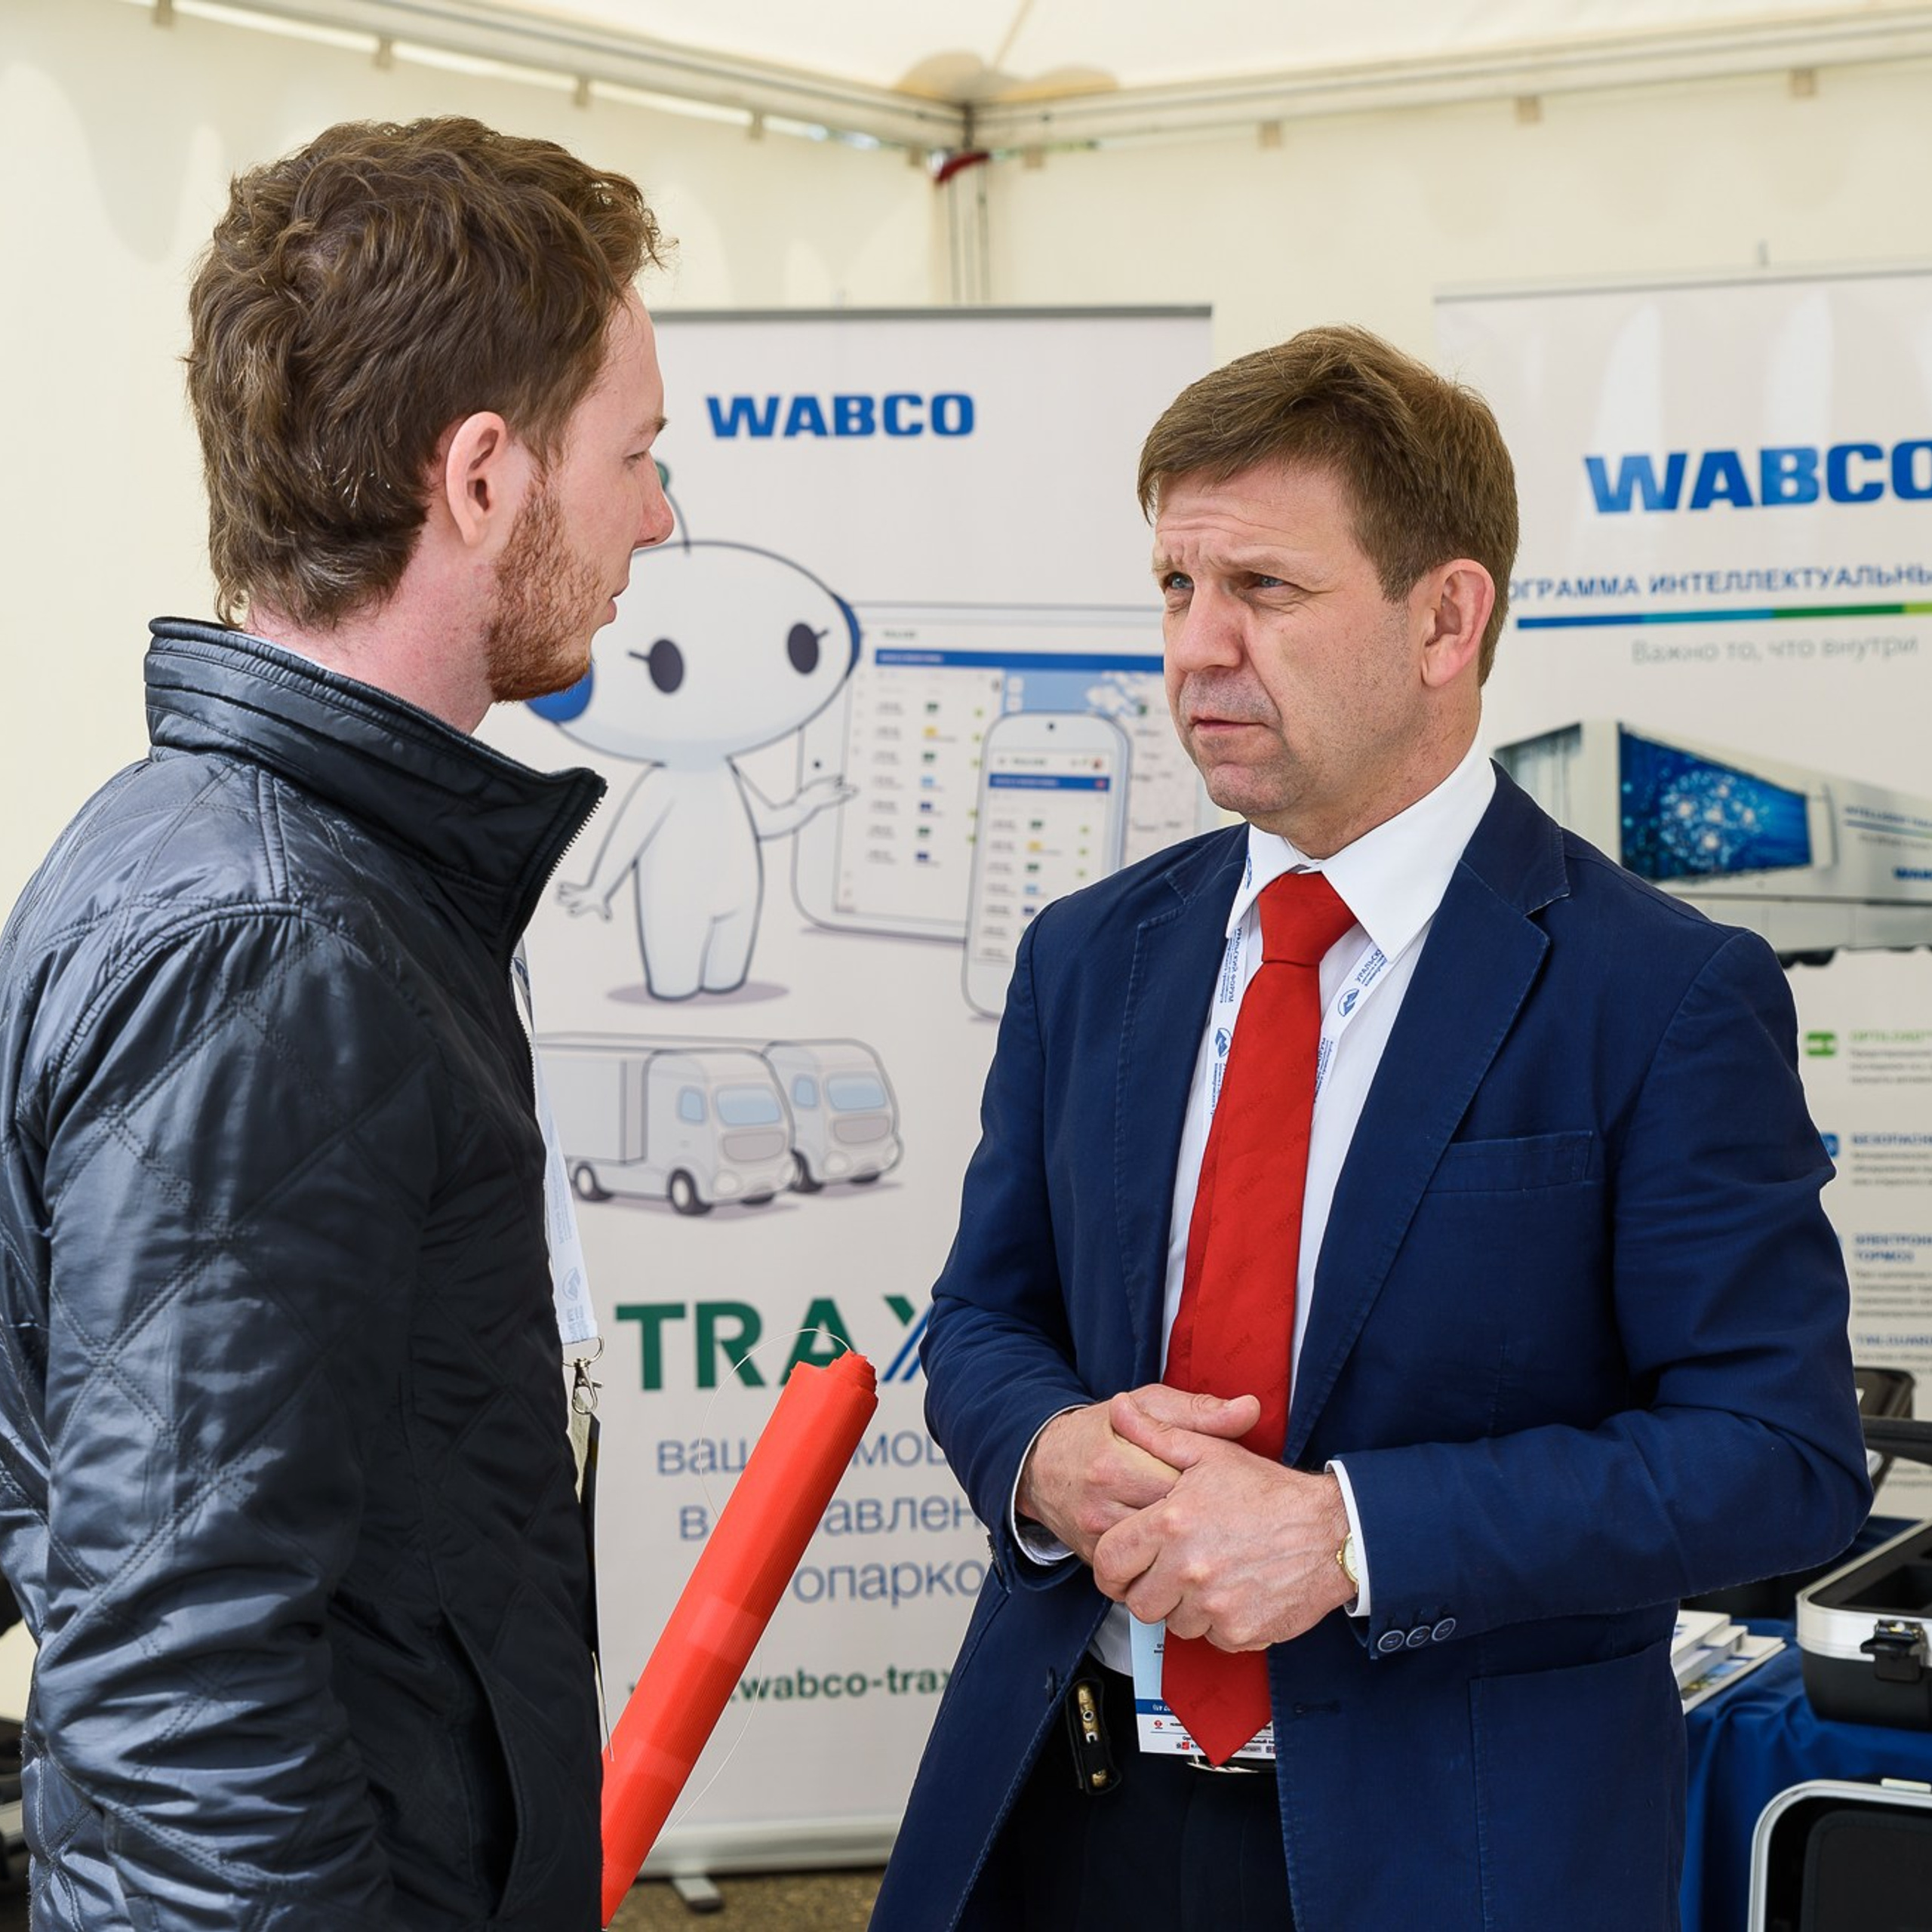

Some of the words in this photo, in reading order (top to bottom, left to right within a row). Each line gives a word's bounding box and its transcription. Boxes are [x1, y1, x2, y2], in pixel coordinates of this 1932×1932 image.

[706, 393, 974, 438] WABCO
[1585, 440, 1932, 513] WABCO
[1509, 577, 1640, 601] ОГРАММА
[1632, 641, 1719, 664] Важно
[1768, 640, 1814, 659] что
[1822, 636, 1918, 662] внутри
[680, 1505, 709, 1541] в
[792, 1559, 986, 1608] опарко
